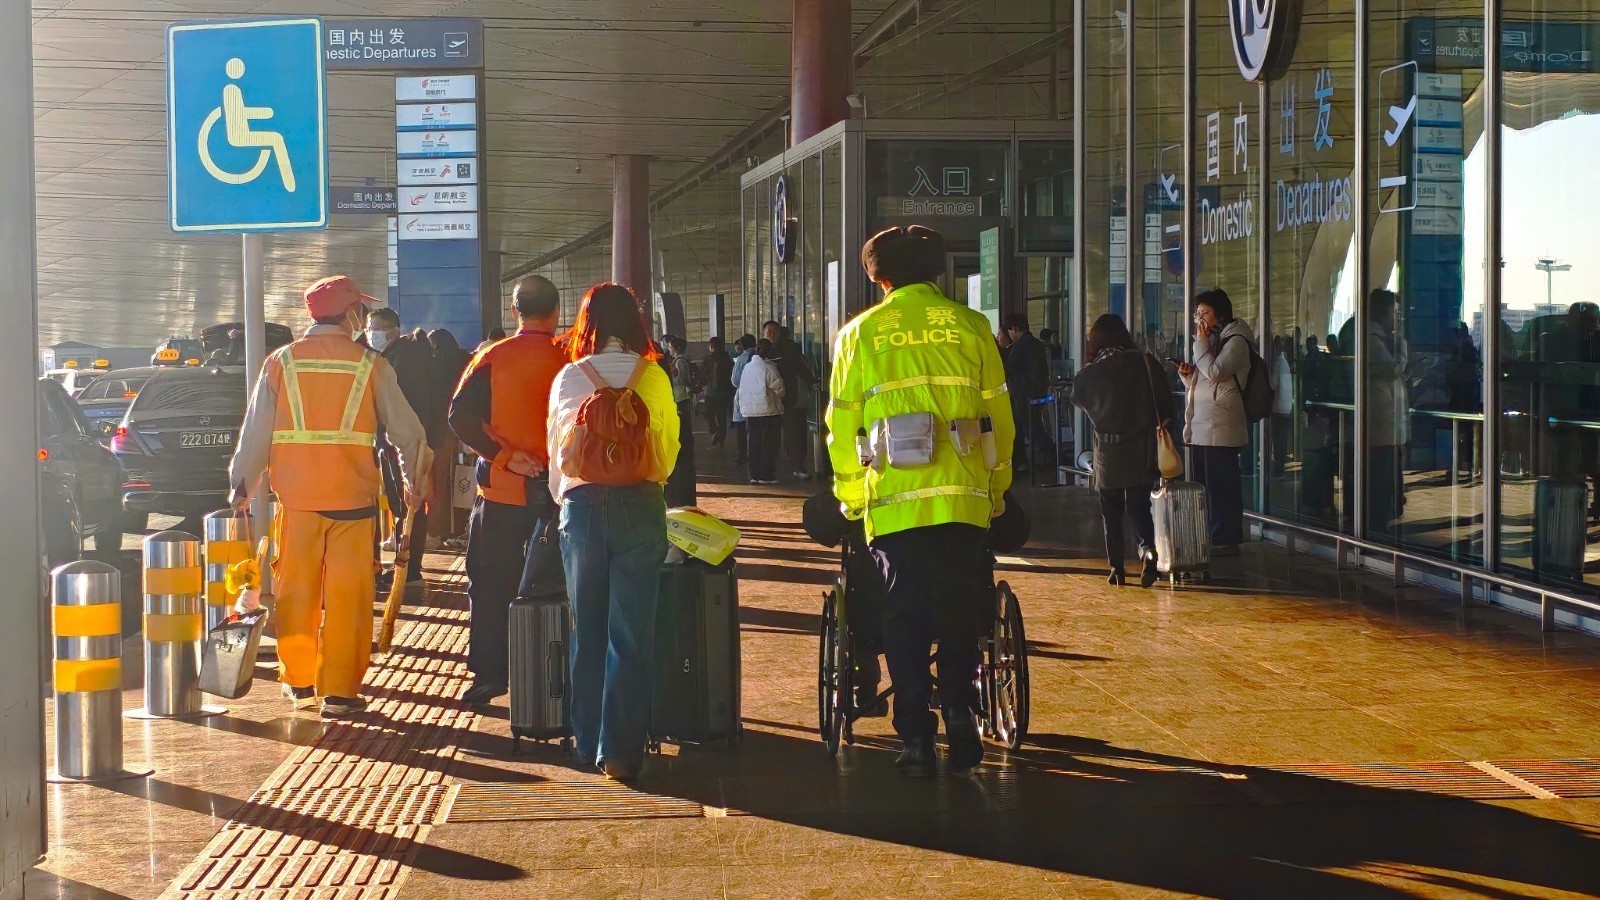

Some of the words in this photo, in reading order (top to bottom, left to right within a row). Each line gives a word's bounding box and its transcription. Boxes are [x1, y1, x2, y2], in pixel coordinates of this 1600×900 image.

[329, 28, 406, 46] 国内出发
[364, 47, 437, 61] Departures
[907, 165, 970, 197] 入口
[353, 192, 394, 201] 国内出发
[903, 199, 975, 215] Entrance
[1201, 191, 1253, 245] Domestic
[1276, 172, 1351, 240] Departures
[875, 306, 957, 333] 警察
[873, 328, 961, 351] POLICE
